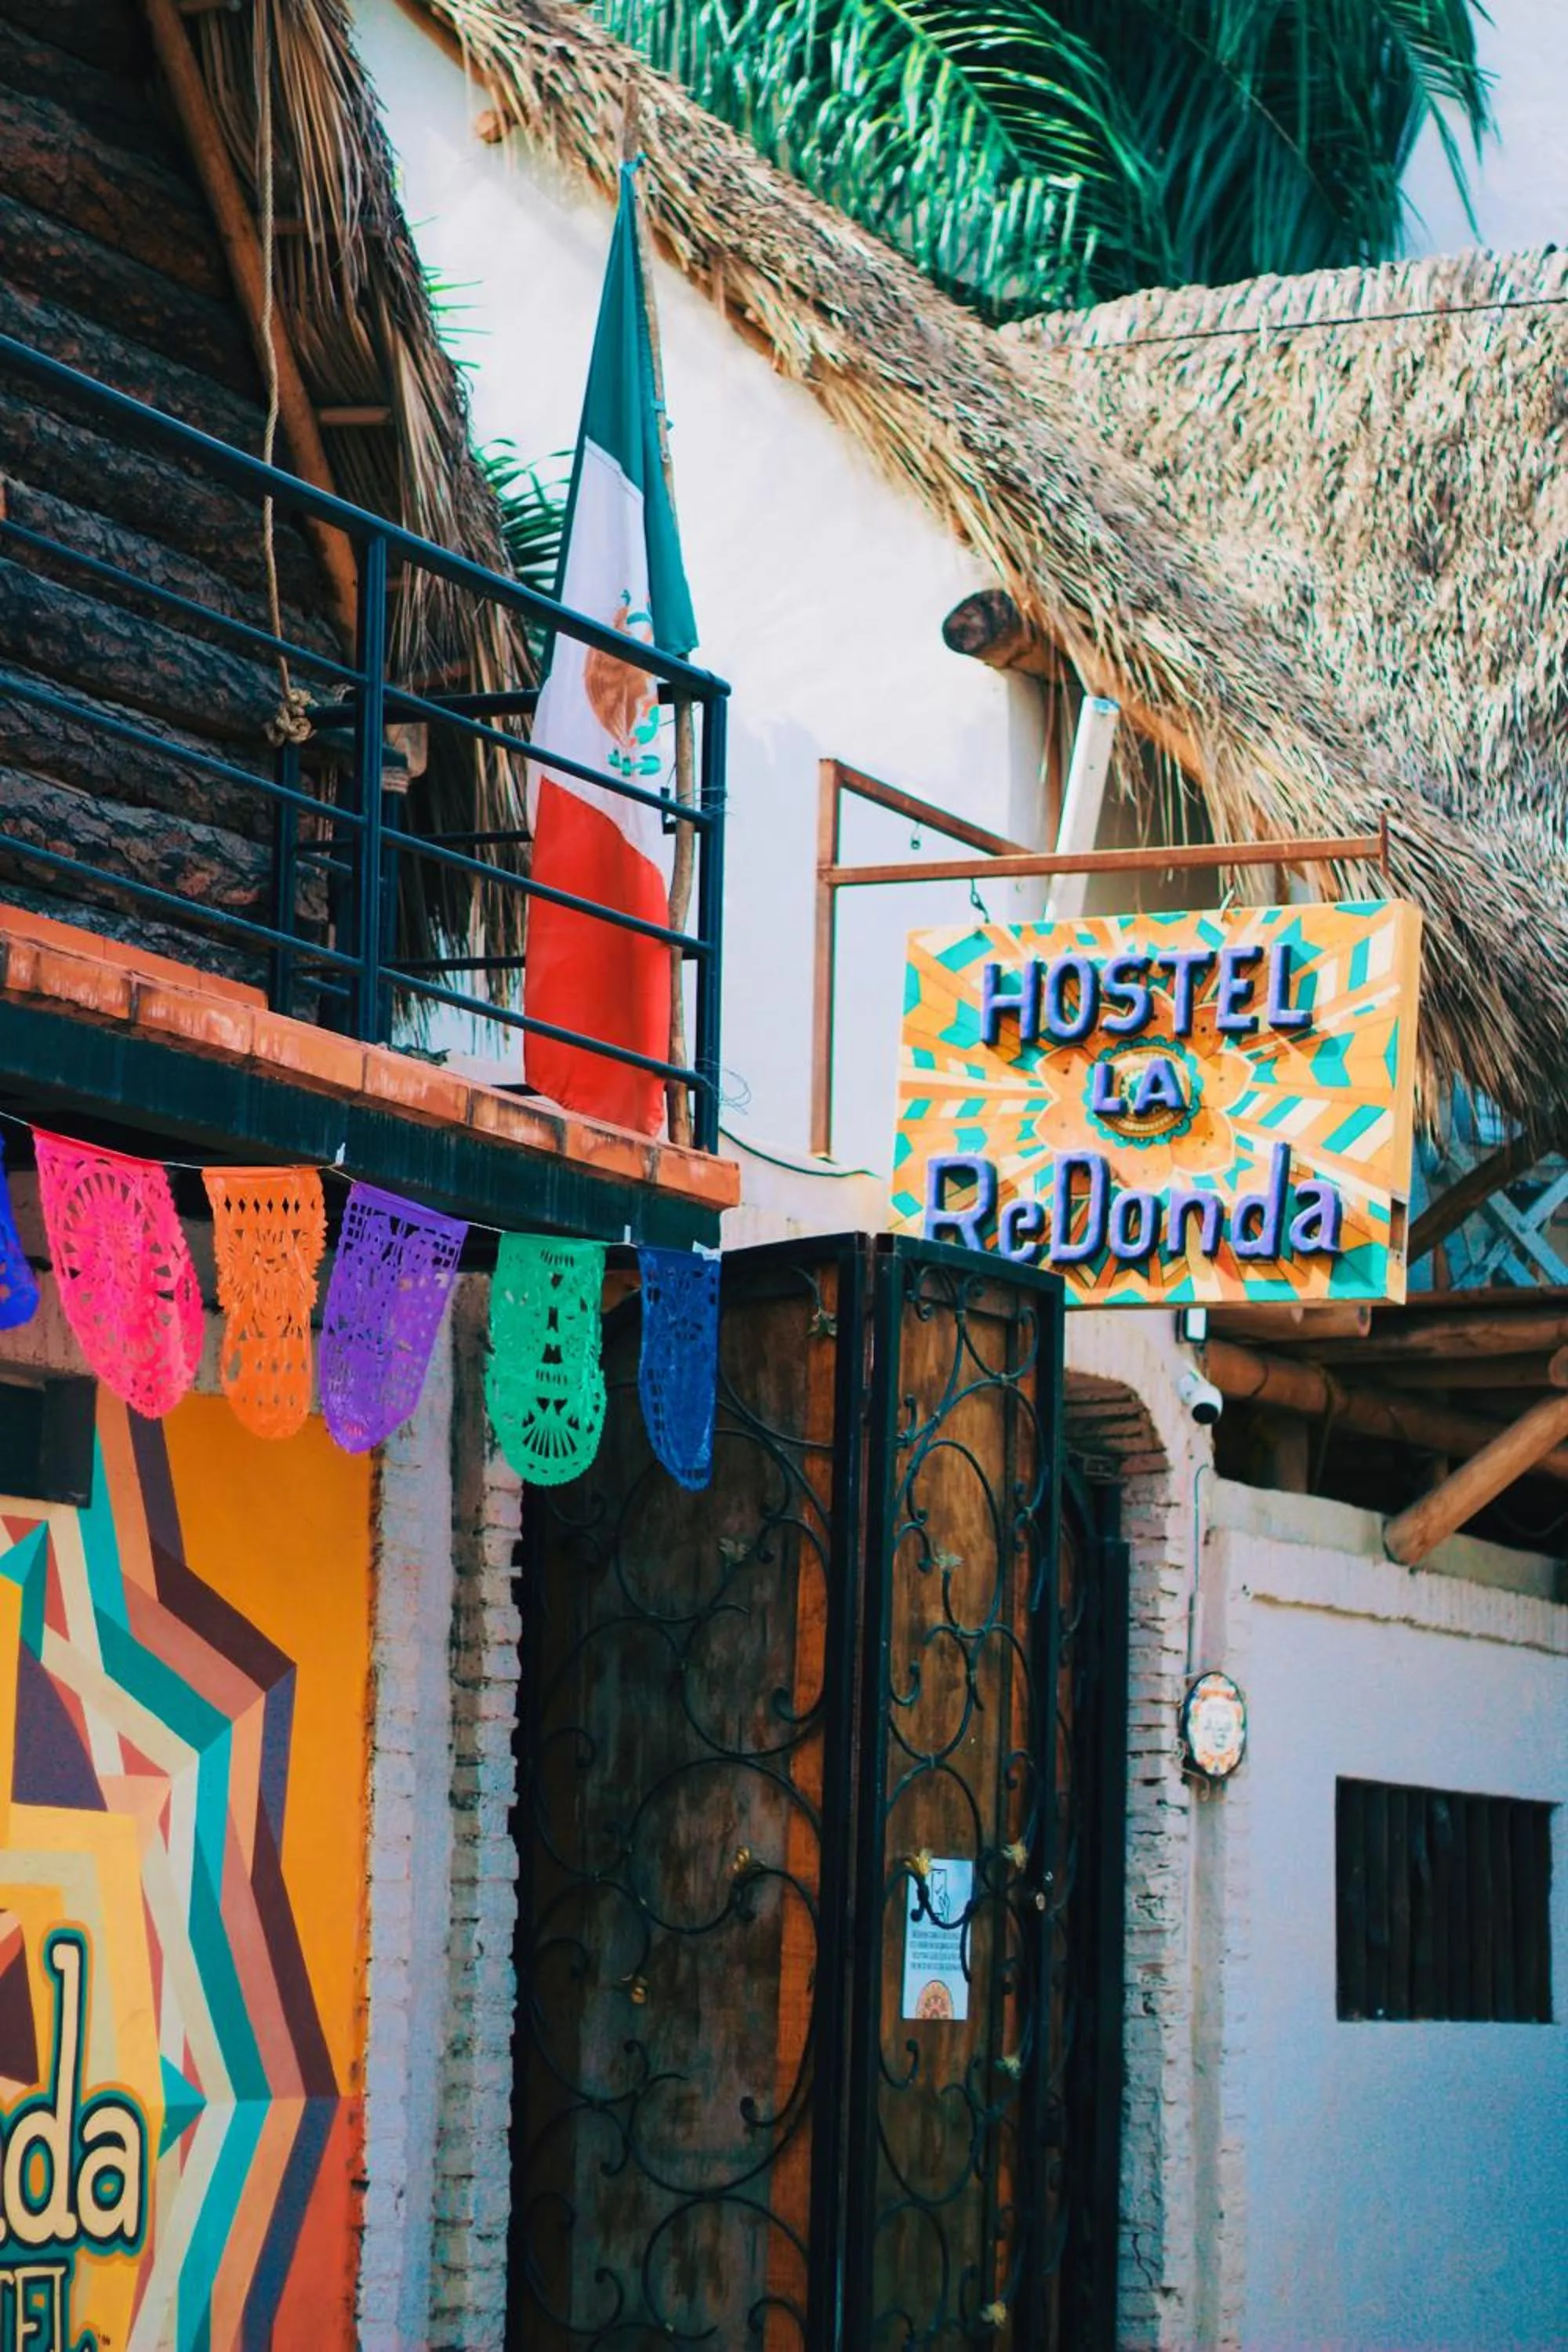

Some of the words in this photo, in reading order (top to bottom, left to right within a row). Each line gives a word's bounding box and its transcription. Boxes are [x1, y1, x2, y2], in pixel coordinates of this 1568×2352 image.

[981, 943, 1313, 1047] HOSTEL
[1093, 1058, 1192, 1118] LA
[924, 1141, 1346, 1266] ReDonda
[0, 1942, 141, 2245] da
